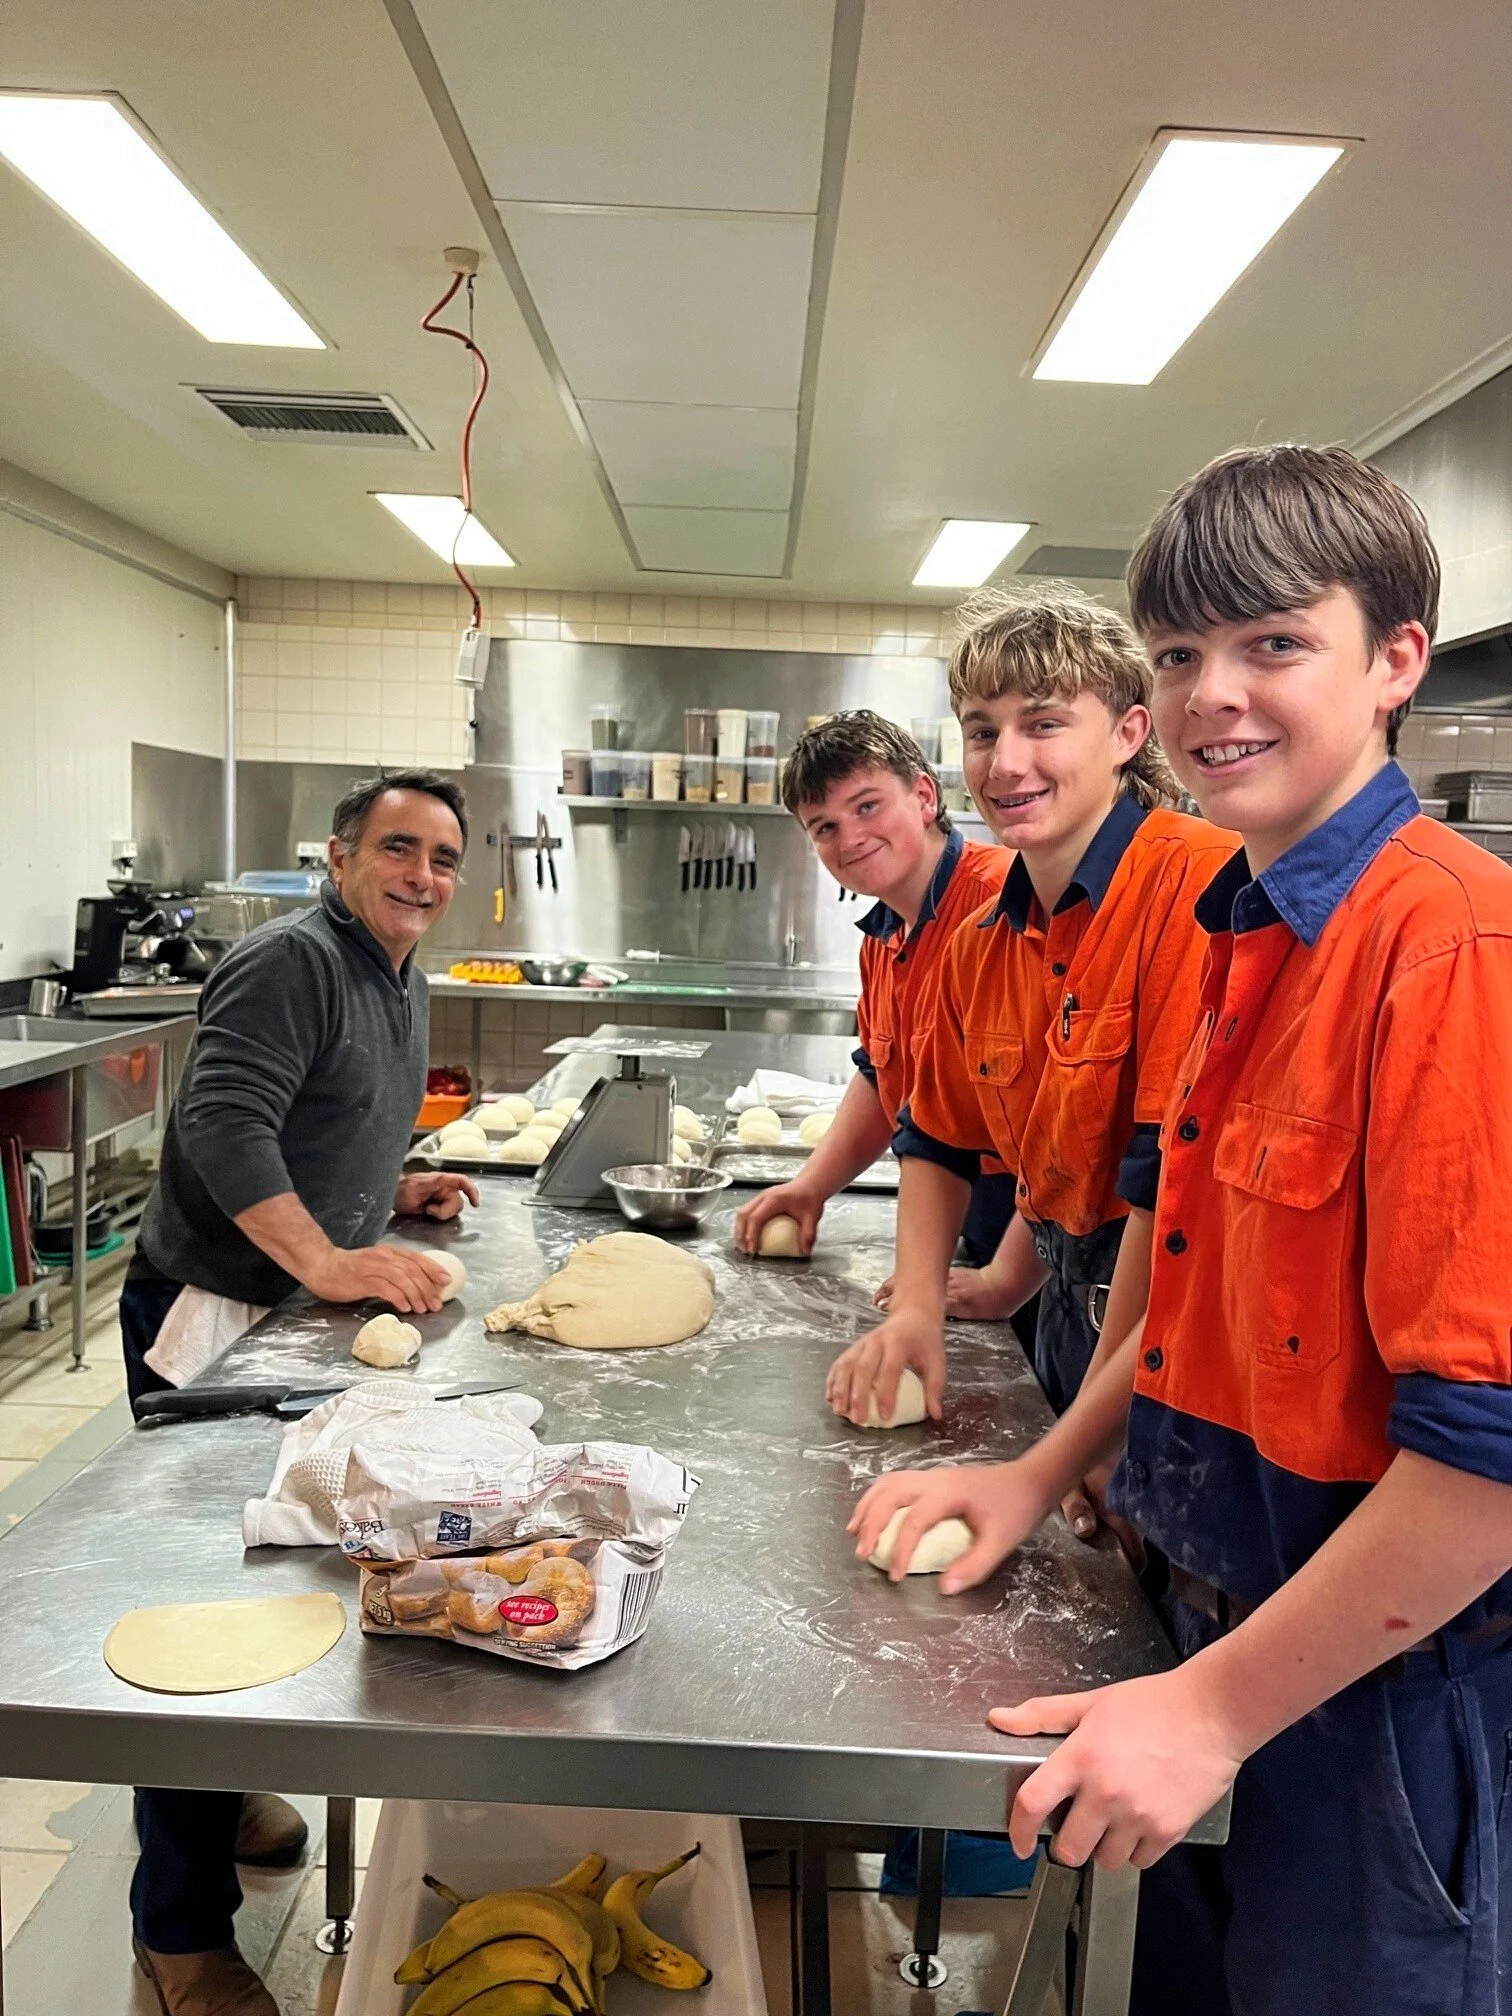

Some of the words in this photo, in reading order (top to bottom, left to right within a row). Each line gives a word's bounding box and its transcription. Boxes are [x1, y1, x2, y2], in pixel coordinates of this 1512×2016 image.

[520, 1600, 551, 1615] recipes
[522, 1609, 546, 1622] pack
[494, 1638, 519, 1648] SERVING
[519, 1641, 556, 1650] SUGGESTION
